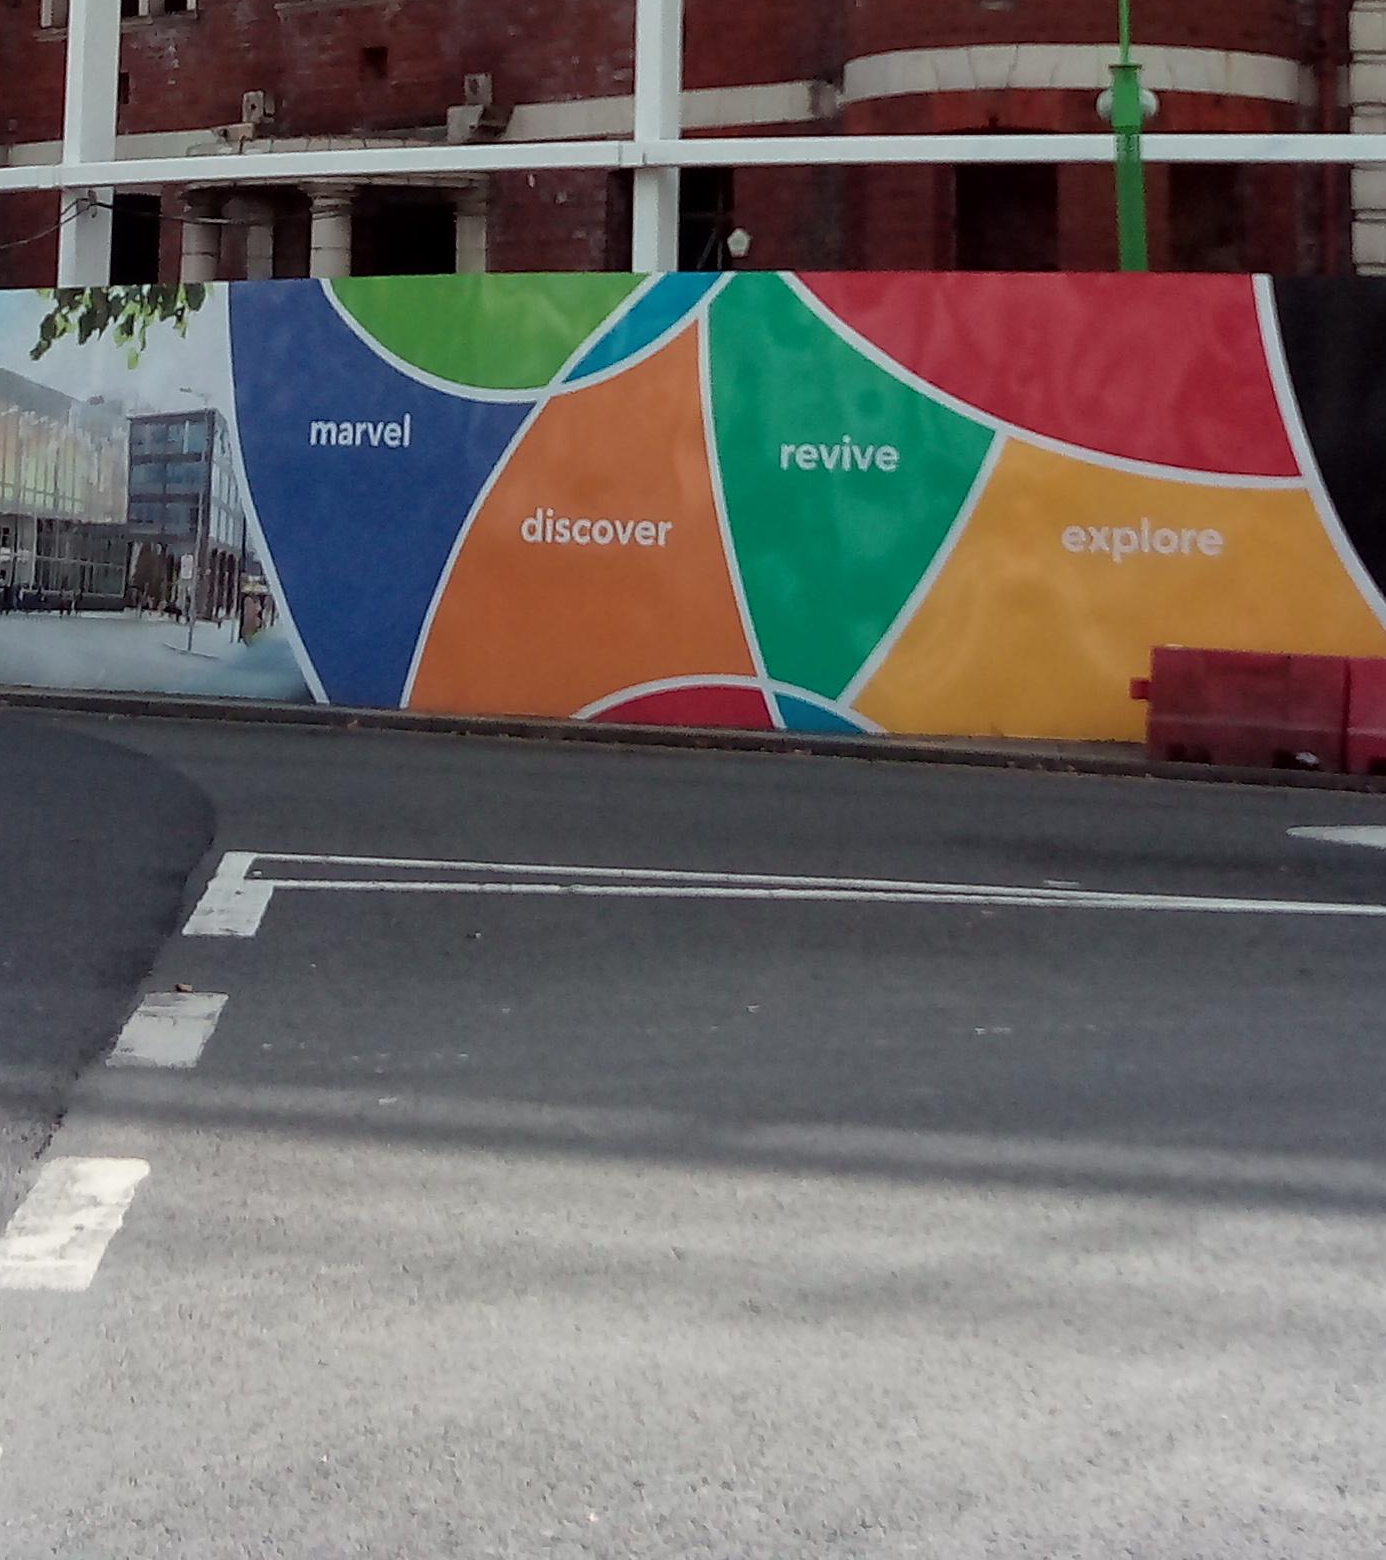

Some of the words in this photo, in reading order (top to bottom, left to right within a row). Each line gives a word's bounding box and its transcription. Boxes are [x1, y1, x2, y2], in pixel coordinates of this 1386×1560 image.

[310, 413, 411, 448] marvel
[779, 434, 900, 471] revive
[521, 508, 673, 545] discover
[1061, 517, 1223, 562] explore
